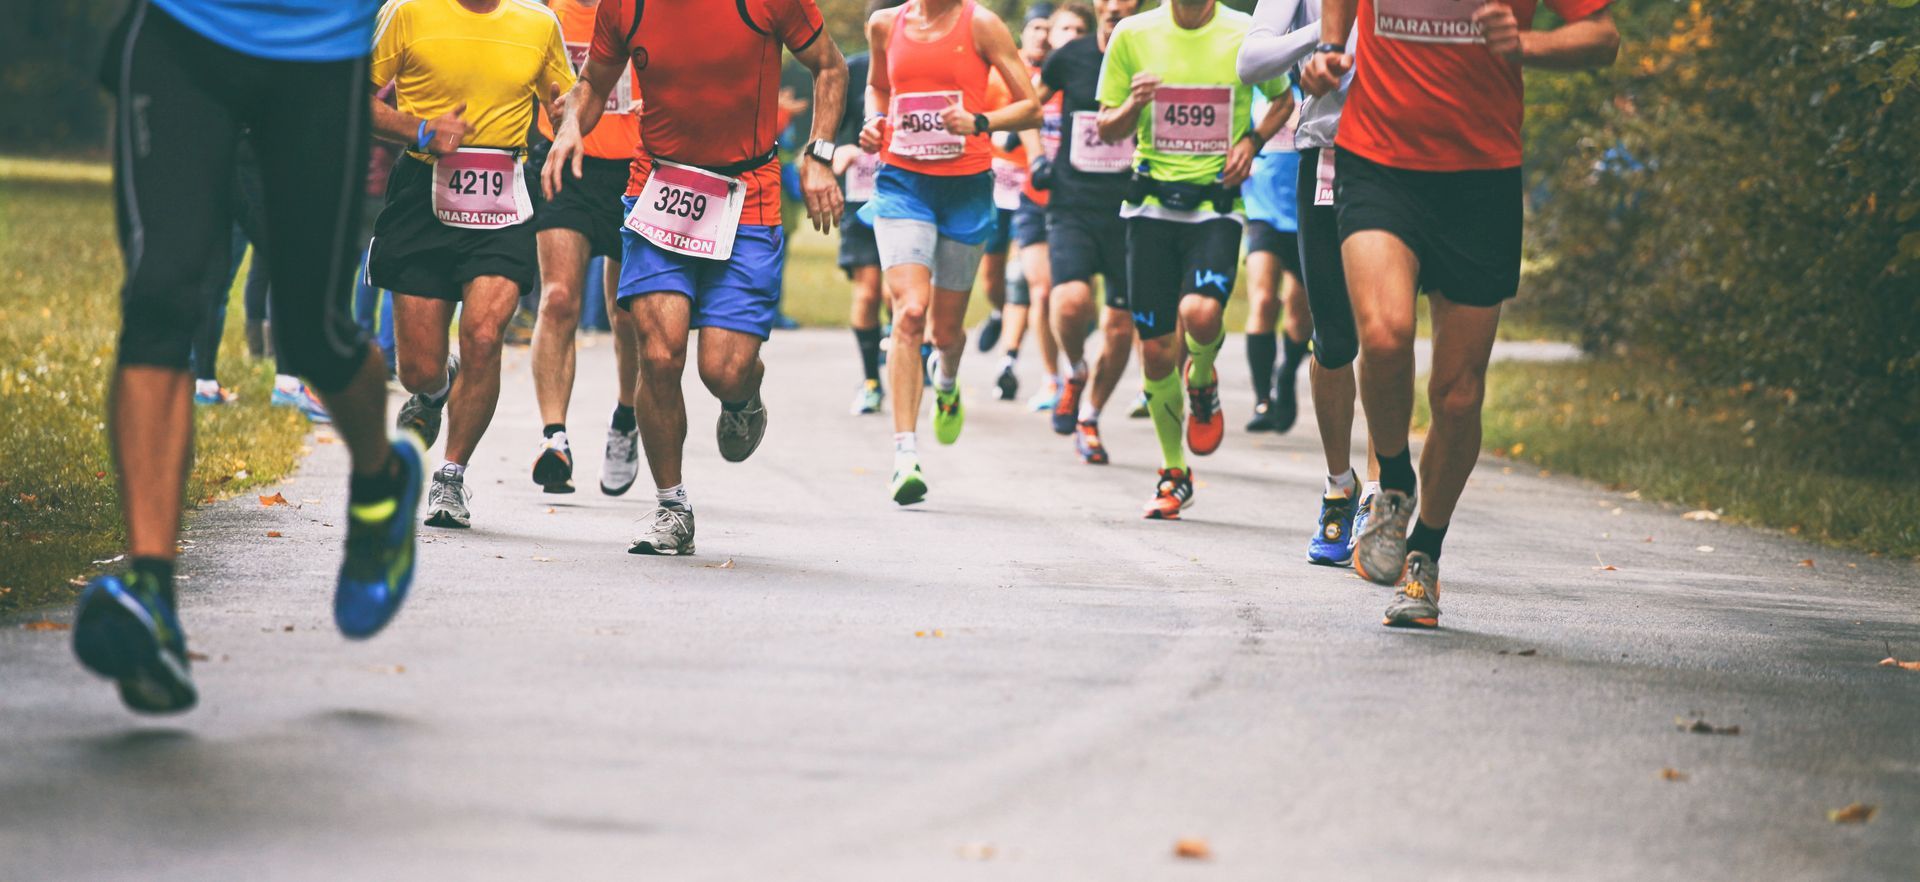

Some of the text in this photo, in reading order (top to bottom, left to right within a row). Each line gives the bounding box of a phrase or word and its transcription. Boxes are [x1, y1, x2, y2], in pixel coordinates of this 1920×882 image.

[1380, 16, 1482, 35] MARATHON
[1164, 104, 1215, 127] 4599
[1156, 139, 1228, 151] MARATHON
[449, 170, 503, 196] 4219
[654, 186, 707, 221] 3259
[438, 210, 516, 224] MARATHON
[631, 219, 713, 253] MARATHON
